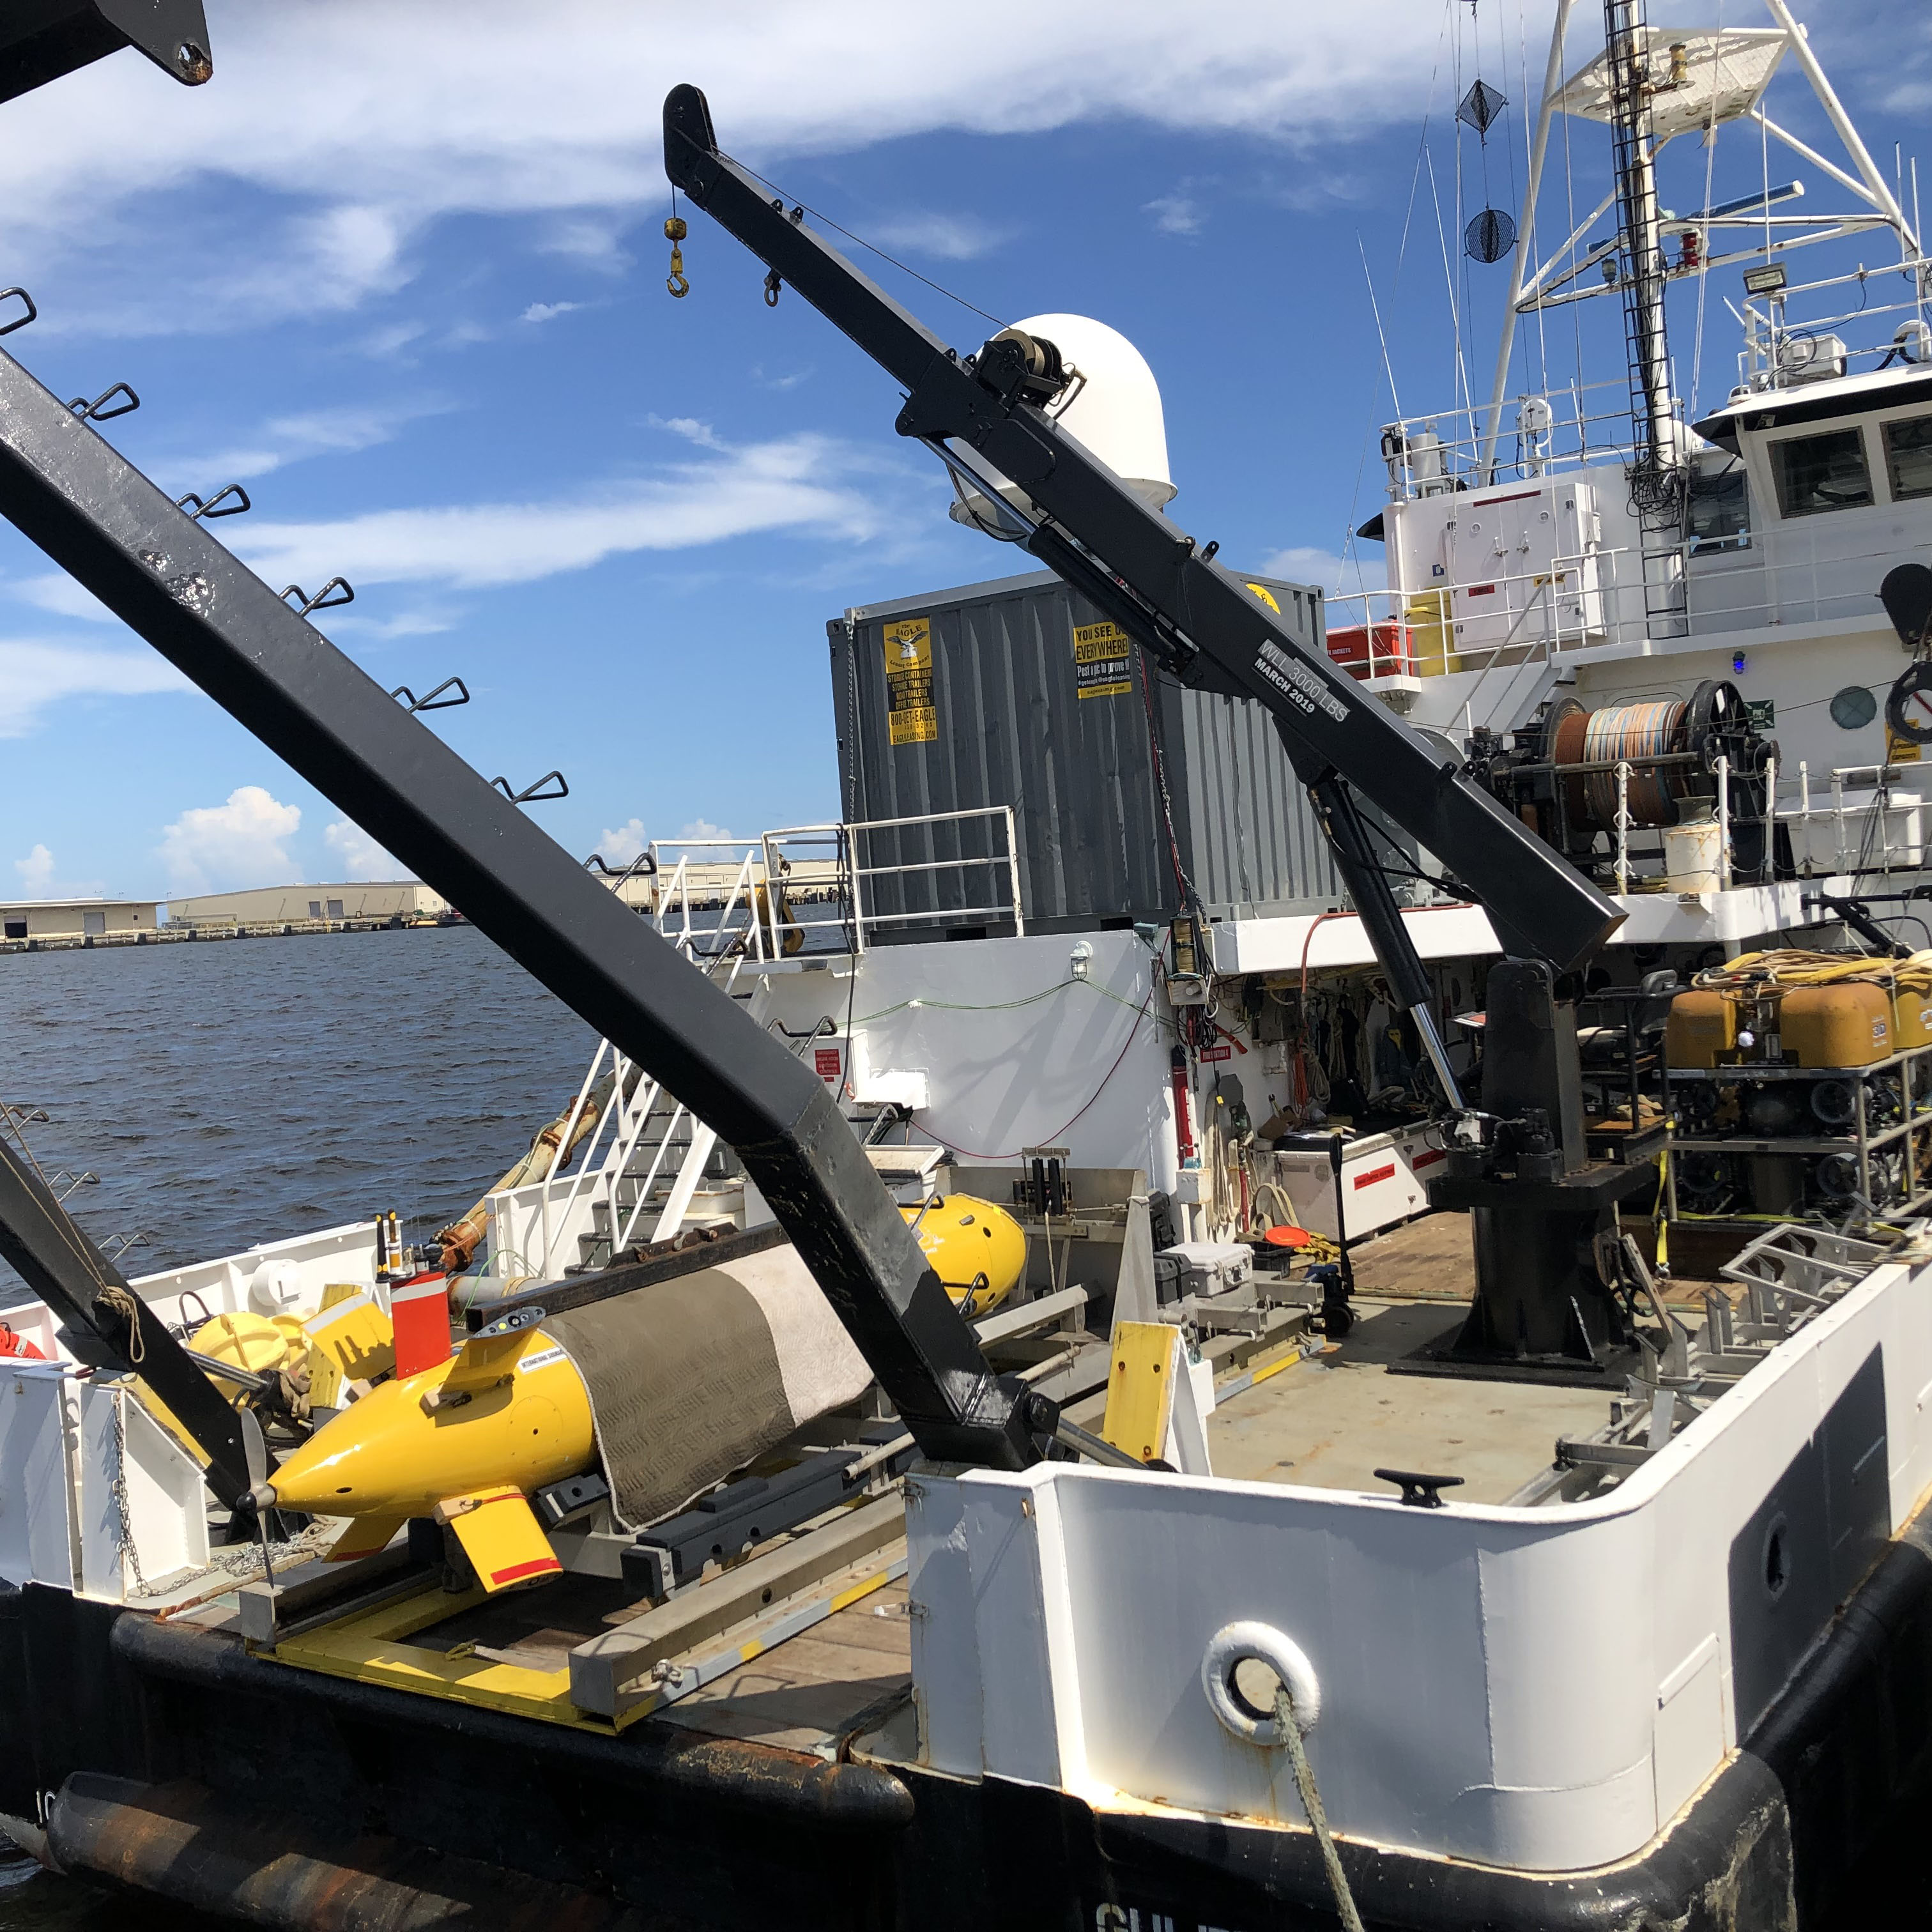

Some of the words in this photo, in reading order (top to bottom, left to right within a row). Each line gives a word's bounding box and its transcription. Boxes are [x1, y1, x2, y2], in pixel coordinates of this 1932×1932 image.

[896, 624, 923, 636] EAGLE
[1076, 628, 1092, 641] YOU
[1094, 625, 1112, 638] SEE
[906, 655, 930, 667] Company
[1077, 664, 1090, 677] Post
[1100, 662, 1107, 673] to
[1107, 661, 1124, 675] prove
[908, 678, 931, 689] TRAILERS
[1254, 657, 1291, 693] MARCH
[1289, 689, 1315, 713] 2019
[1262, 640, 1287, 672] WLL
[1289, 667, 1321, 698] 3000
[1319, 693, 1349, 722] LBS
[905, 687, 928, 698] TRAILERS
[907, 697, 930, 708] TRAILERS
[891, 708, 935, 726] 800-GET-EAGLE
